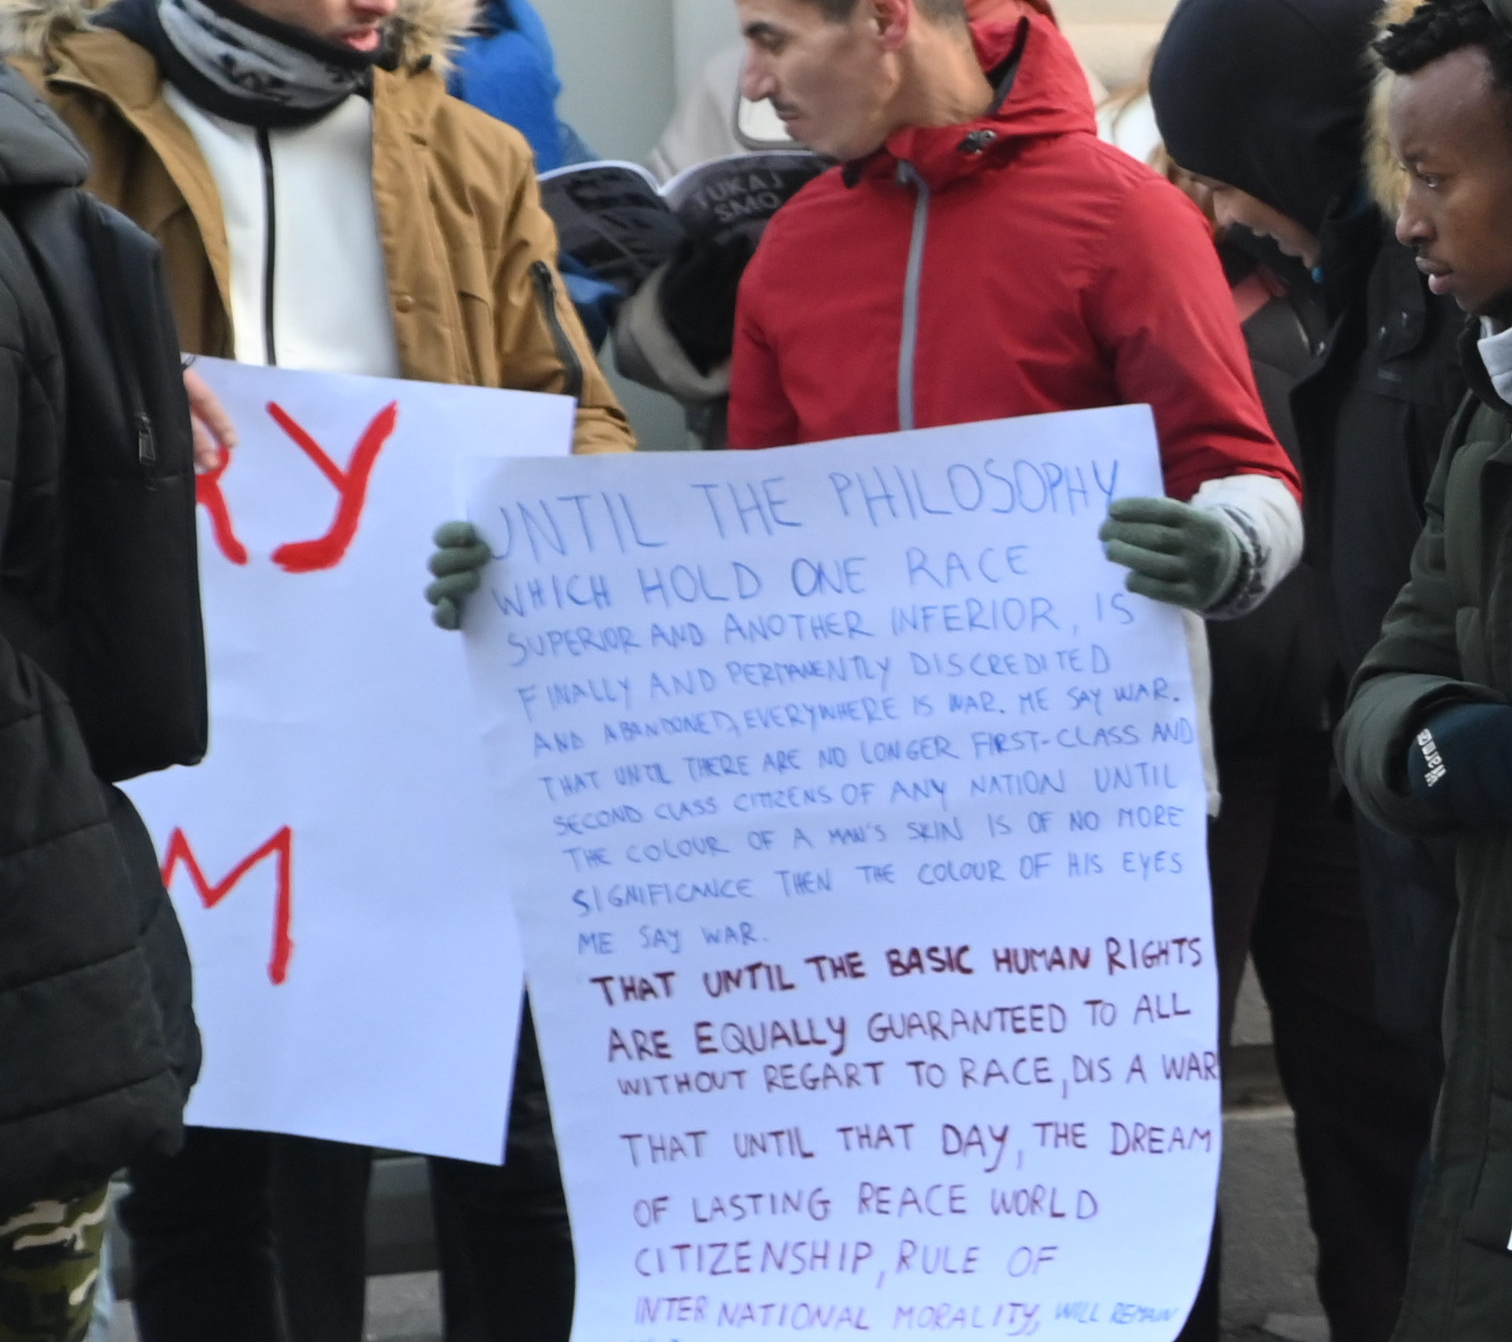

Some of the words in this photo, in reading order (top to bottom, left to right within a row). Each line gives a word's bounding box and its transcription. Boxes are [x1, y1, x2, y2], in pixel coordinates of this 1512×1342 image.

[714, 191, 782, 223] SMO
[690, 476, 803, 541] THE
[828, 458, 1118, 527] PHILOSOPHY
[491, 573, 611, 617] WHICH
[637, 561, 762, 607] HOLD
[792, 557, 866, 597] ONE
[905, 545, 1029, 588] RACE
[507, 626, 641, 667] SUPERIOR
[650, 622, 704, 650] AND
[724, 611, 875, 645] ANOTHER
[1097, 592, 1135, 625] IS
[516, 676, 632, 724] FINALLY
[649, 668, 717, 699] AND
[908, 644, 1111, 677] DISCREDITED
[533, 730, 584, 758] AND
[744, 697, 900, 731] EVERYWHERE
[912, 695, 933, 716] IS
[1018, 687, 1050, 715] ME
[1066, 686, 1103, 716] SAY
[1113, 677, 1181, 703] WAR.
[538, 770, 600, 803] THAT
[614, 762, 673, 788] UNTIL
[682, 753, 750, 783] THERE
[762, 748, 803, 774] ARE
[817, 745, 847, 769] NO
[860, 735, 960, 765] LONGER
[1150, 717, 1193, 745] AND
[552, 803, 643, 837] SECOND
[653, 795, 719, 822] CLASS
[840, 782, 876, 806] OF
[889, 777, 950, 812] ANY
[969, 769, 1067, 796] NATION
[1092, 762, 1178, 794] UNTIL
[561, 846, 612, 873] THE
[625, 835, 730, 864] COLOUR
[746, 829, 775, 851] OF
[792, 827, 813, 850] A
[906, 816, 964, 842] SKIN
[986, 812, 1013, 839] IS
[1027, 810, 1055, 835] OF
[1068, 810, 1100, 833] NO
[1116, 805, 1185, 829] MORE
[774, 867, 834, 898] THEN
[855, 863, 896, 886] THE
[917, 860, 1006, 886] COLOUR
[1019, 851, 1053, 880] OF
[1067, 851, 1104, 878] HIS
[1122, 850, 1184, 882] EYES
[577, 931, 614, 956] ME
[638, 924, 682, 955] SAY
[588, 970, 677, 1007] THAT
[701, 961, 797, 999] UNTIL
[804, 950, 868, 983] THE
[884, 944, 974, 977] BASIC
[991, 945, 1091, 976] HUMAN
[1104, 935, 1203, 976] RIGHTS
[607, 1027, 673, 1064] ARE
[693, 1015, 848, 1058] EQUALLY
[866, 1003, 1067, 1042] GUARANTEED
[1082, 998, 1118, 1027] TO
[1132, 992, 1192, 1024] ALL
[616, 1068, 748, 1098] WITHOUT
[762, 1060, 885, 1093] REGART
[905, 1059, 947, 1089] TO
[1124, 1053, 1148, 1084] A
[1161, 1050, 1218, 1083] WAR
[619, 1130, 708, 1168] THAT
[733, 1126, 815, 1159] UNTIL
[836, 1122, 916, 1152] THAT
[1032, 1120, 1088, 1150] THE
[1109, 1120, 1213, 1156] DREAM
[632, 1195, 671, 1229] OF
[690, 1186, 832, 1224] LASTING
[990, 1183, 1099, 1221] WORLD
[895, 1238, 982, 1276] RULE
[1006, 1245, 1060, 1278] OF
[1054, 1300, 1101, 1323] WILL
